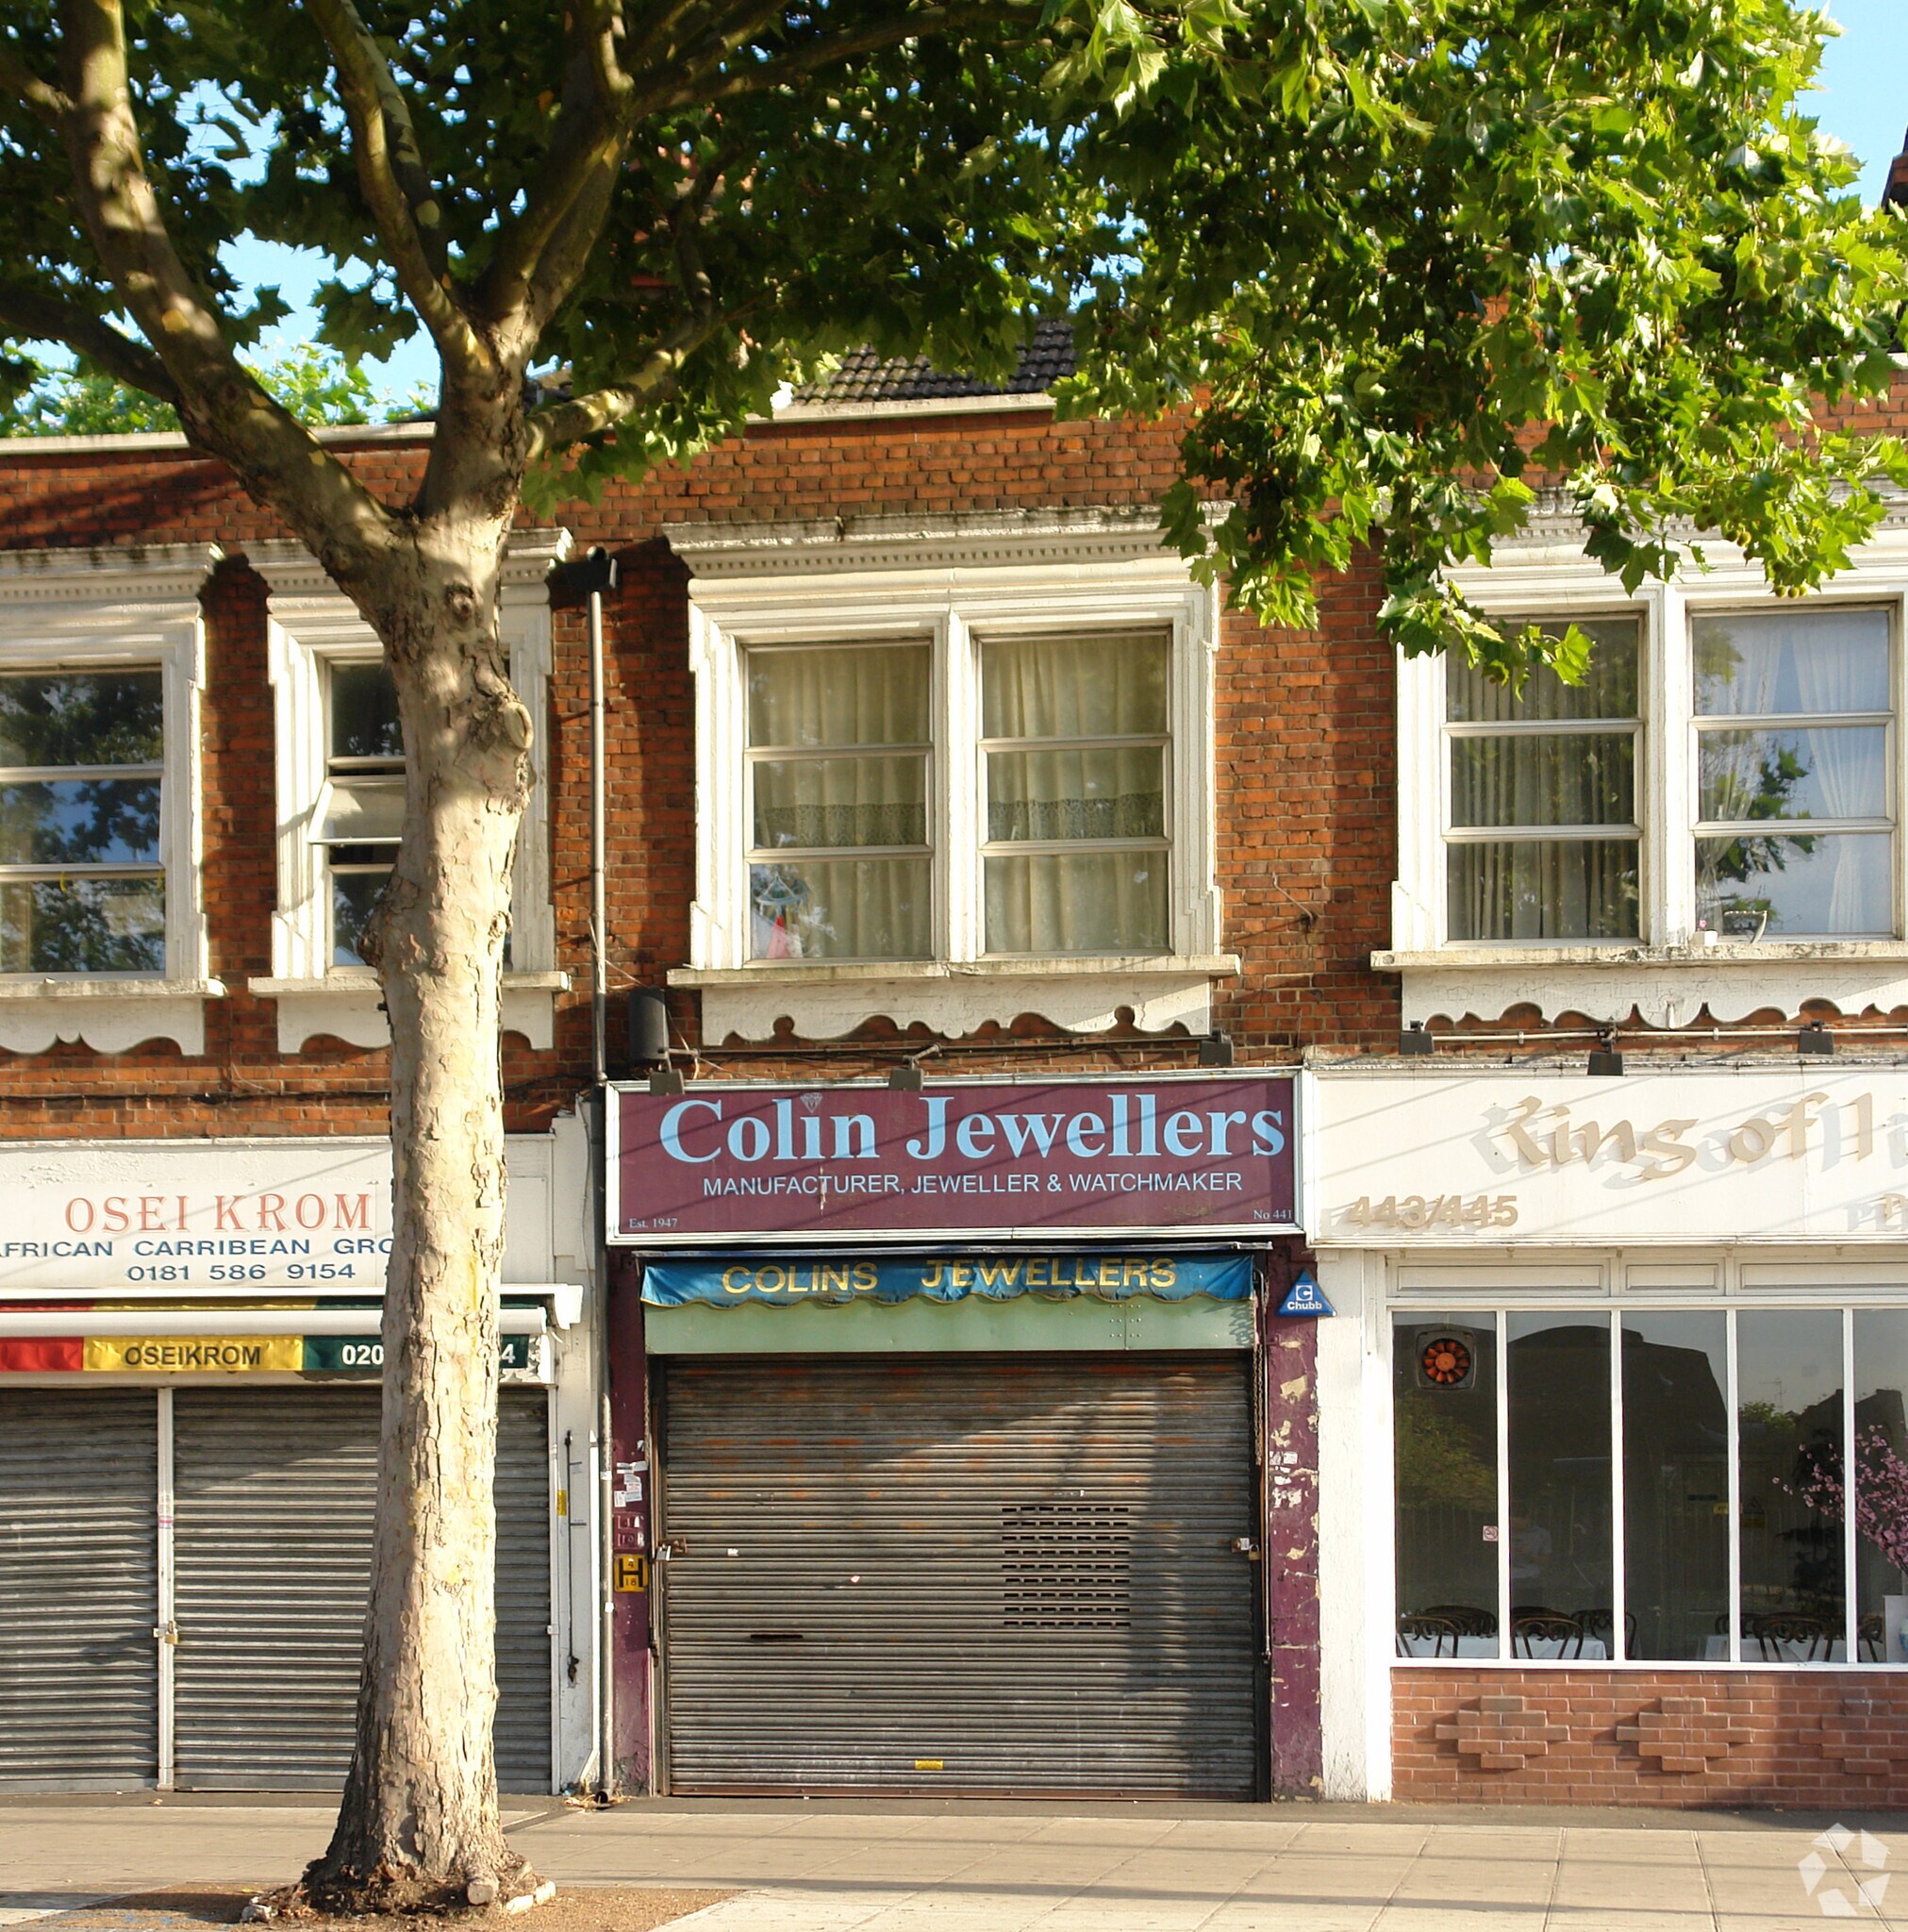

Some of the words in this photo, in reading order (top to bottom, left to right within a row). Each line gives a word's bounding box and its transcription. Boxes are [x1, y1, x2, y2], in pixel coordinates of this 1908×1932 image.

[659, 1098, 881, 1163] Colin
[905, 1093, 1286, 1160] Jewellers
[1729, 1091, 1831, 1163] of
[703, 1174, 905, 1196] MANUFACTURER,
[911, 1174, 1039, 1194] JEWELLER
[1046, 1174, 1063, 1192] &
[1069, 1172, 1243, 1191] WATCHMAKER
[64, 1193, 191, 1233] OSEI
[213, 1192, 373, 1232] KROM
[1253, 1208, 1270, 1220] No
[1272, 1208, 1292, 1220] 441
[1346, 1194, 1519, 1229] 443/445
[629, 1218, 649, 1229] Est.
[653, 1217, 678, 1228] 1947
[0, 1241, 113, 1258] FRICAN
[134, 1239, 310, 1257] CARRIBEAN
[127, 1266, 190, 1282] 0181
[208, 1265, 266, 1281] 586
[287, 1263, 357, 1279] 9154
[721, 1262, 879, 1294] COLINS
[921, 1257, 1178, 1289] JEWELLERS
[1286, 1301, 1323, 1311] Chubb
[124, 1345, 261, 1366] OSEIKROM
